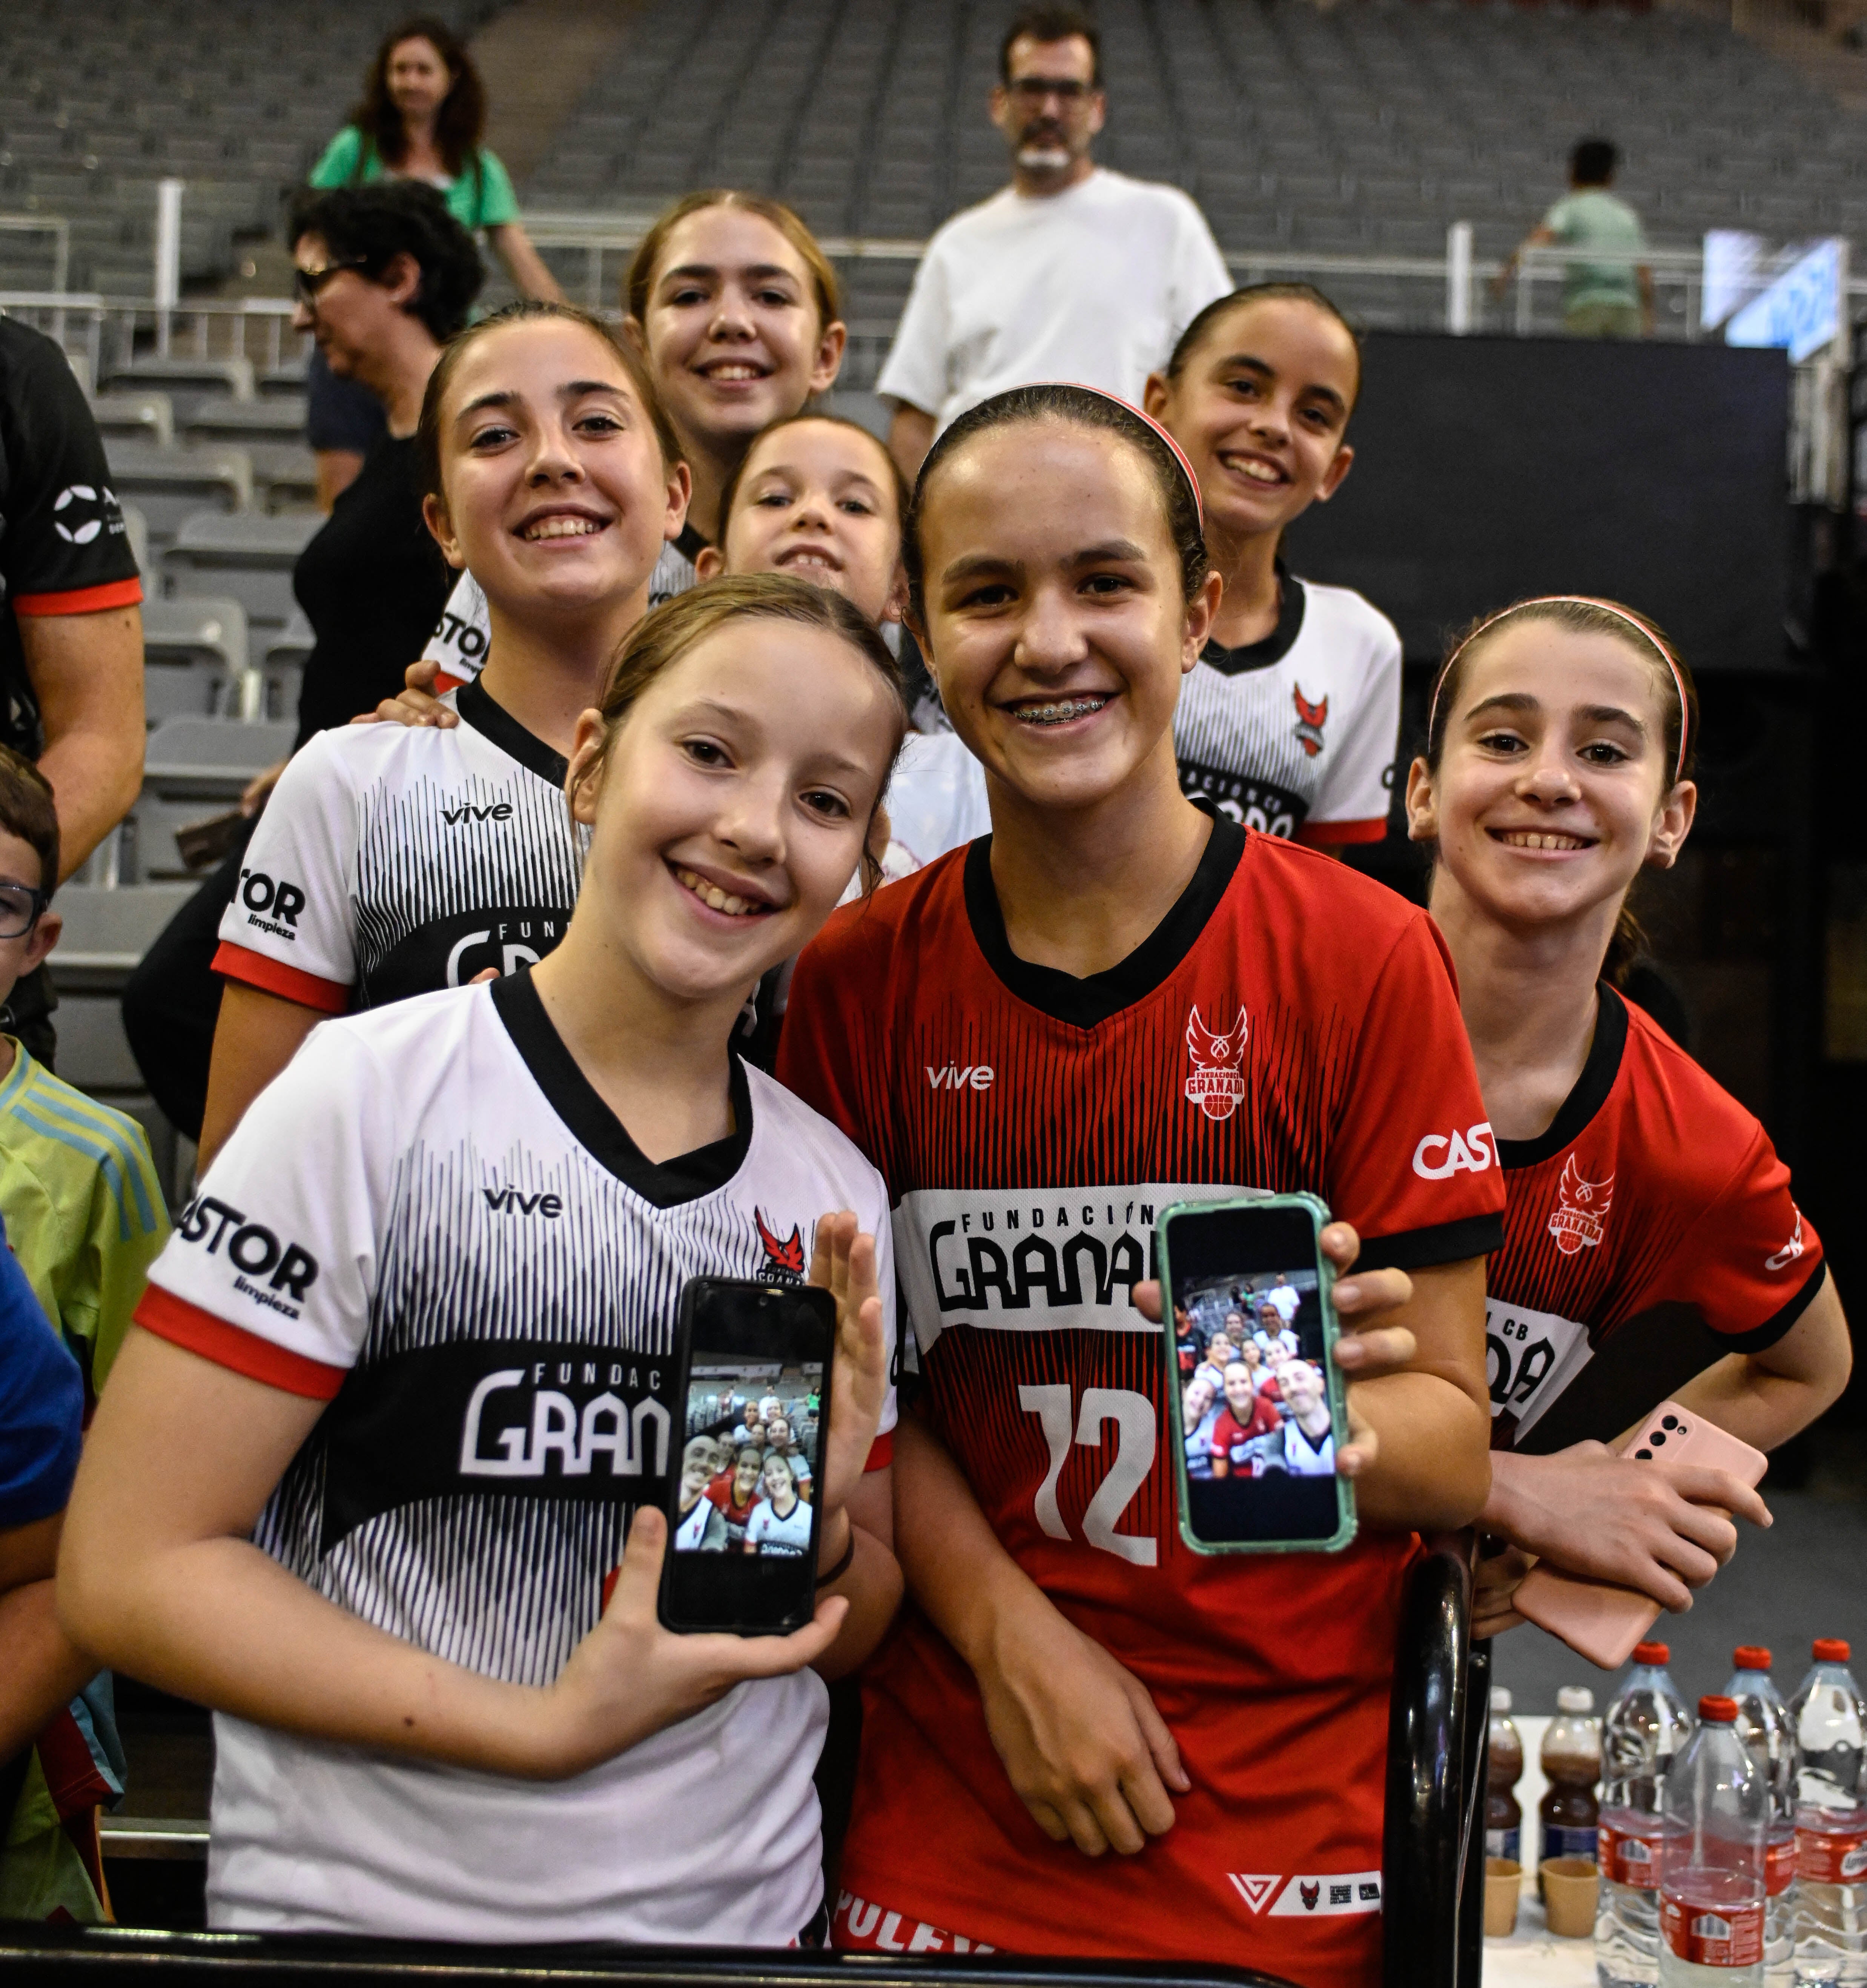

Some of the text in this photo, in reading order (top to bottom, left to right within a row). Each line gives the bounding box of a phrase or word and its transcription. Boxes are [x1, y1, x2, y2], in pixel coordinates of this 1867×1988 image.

[439, 802, 513, 826] vive
[247, 914, 296, 941] limpieza
[499, 921, 572, 940] FUN
[924, 1060, 994, 1090] vive
[1188, 1078, 1243, 1094] GRANADA
[1412, 1122, 1500, 1180] CAS
[482, 1184, 563, 1218] vive
[1551, 1214, 1601, 1243] GRANADA
[929, 1220, 1156, 1312] GRANA
[232, 1275, 300, 1320] limpieza
[1503, 1318, 1529, 1341] CB
[1018, 1384, 1157, 1567] 12
